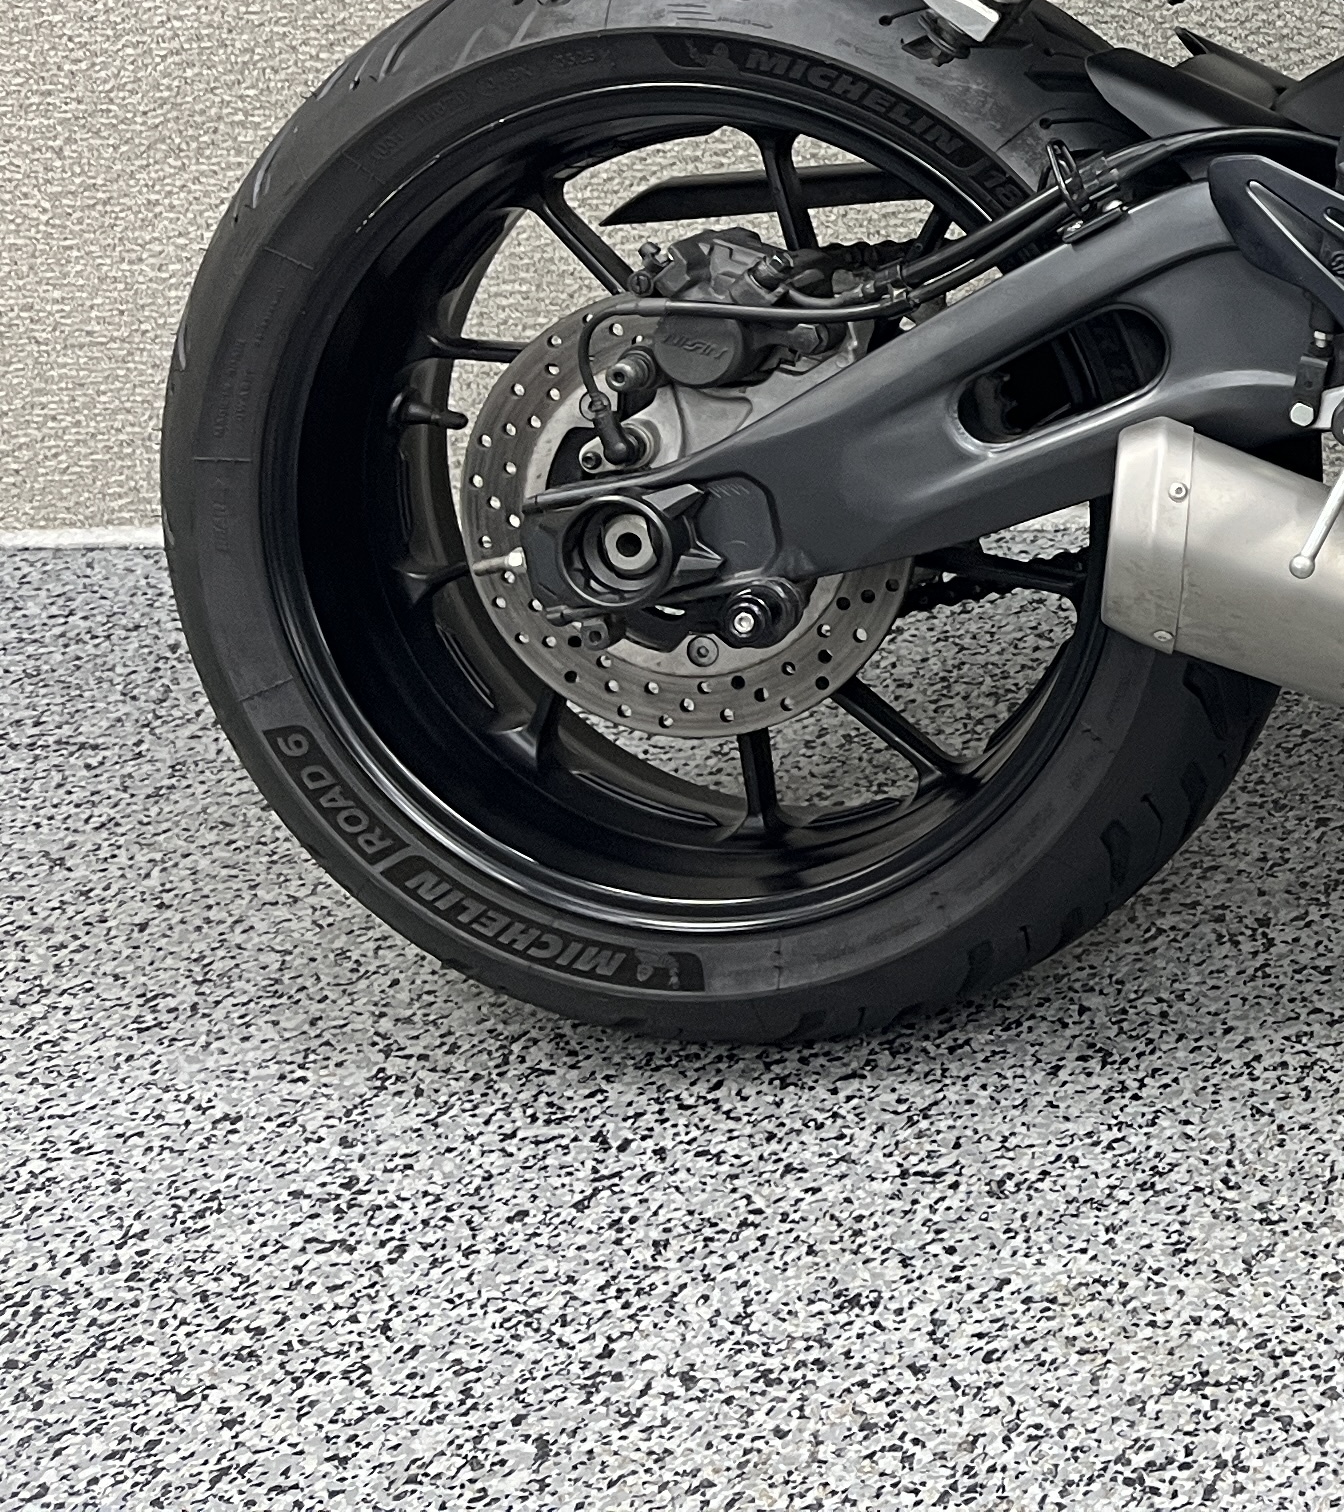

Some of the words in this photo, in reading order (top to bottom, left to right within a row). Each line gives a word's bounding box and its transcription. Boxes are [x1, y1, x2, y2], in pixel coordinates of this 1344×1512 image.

[744, 48, 965, 156] MICHELIN
[276, 732, 310, 758] 6
[301, 765, 391, 855] ROAD
[405, 869, 627, 977] MICHELIN
